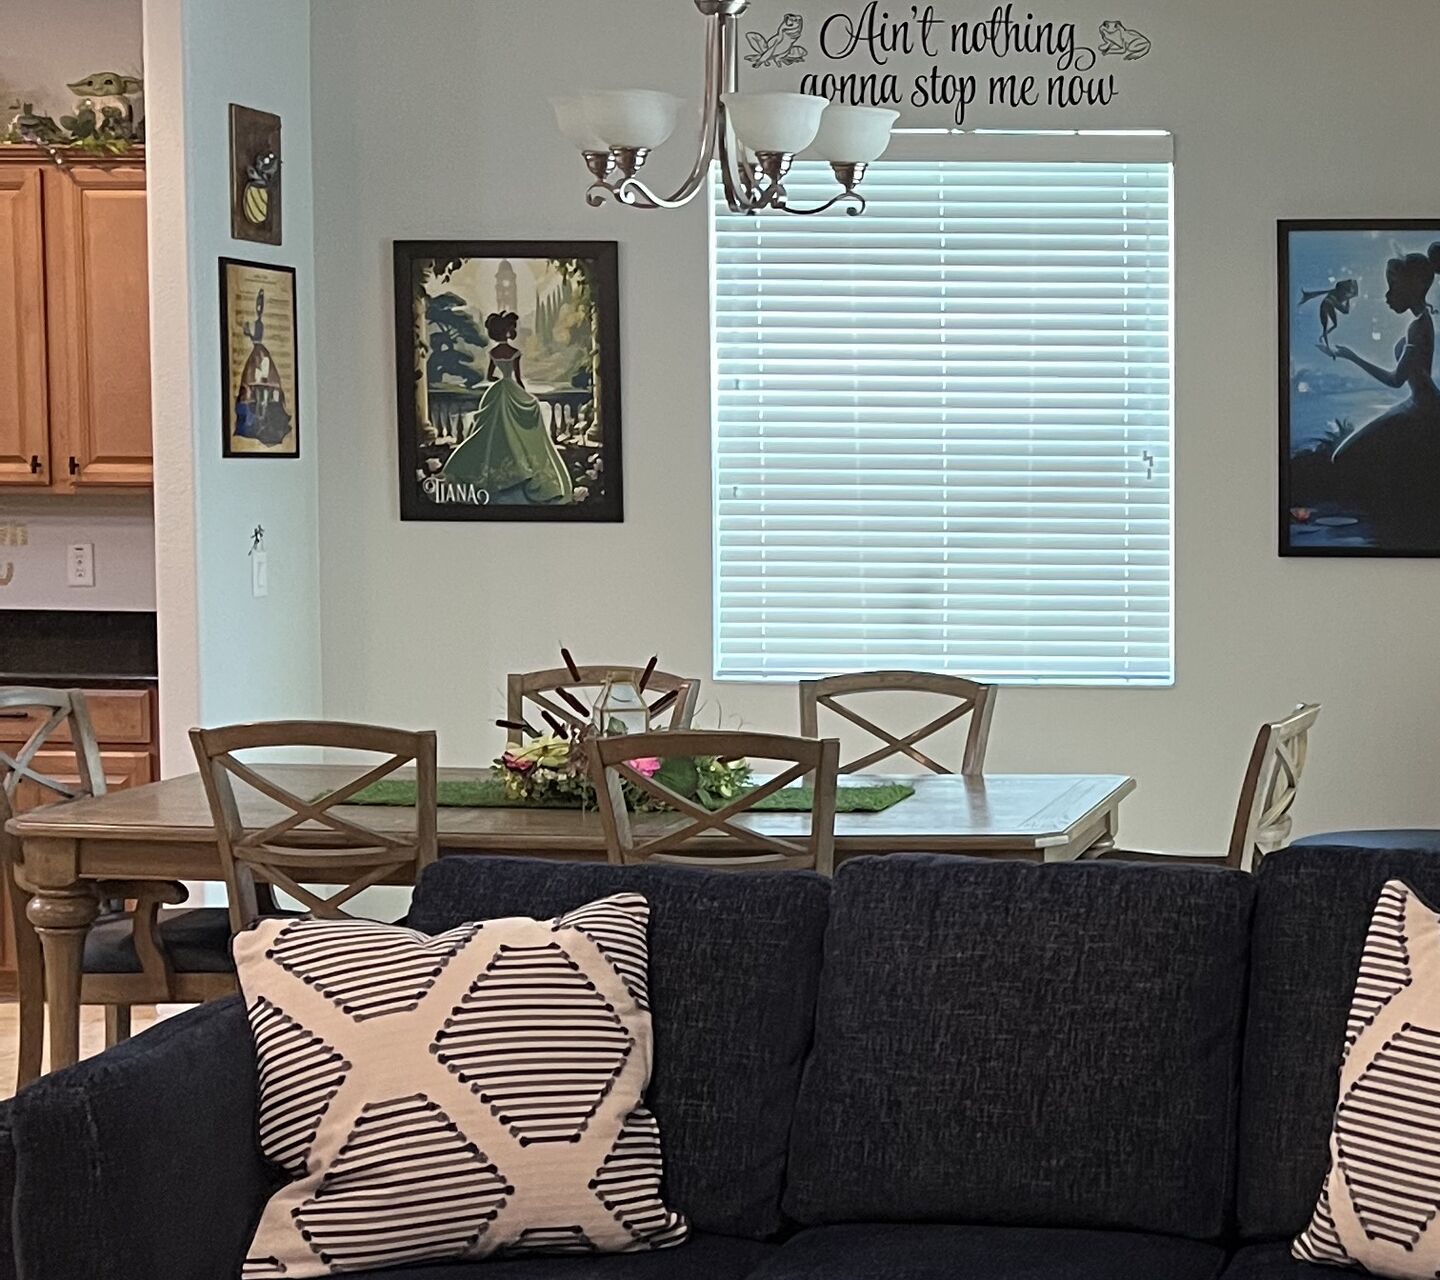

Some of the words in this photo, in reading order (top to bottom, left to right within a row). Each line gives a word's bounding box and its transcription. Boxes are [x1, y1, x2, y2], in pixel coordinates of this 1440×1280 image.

[819, 0, 945, 65] Ain't
[950, 3, 1096, 72] nothing
[910, 66, 977, 125] stop
[988, 72, 1040, 107] me
[1047, 72, 1119, 107] now
